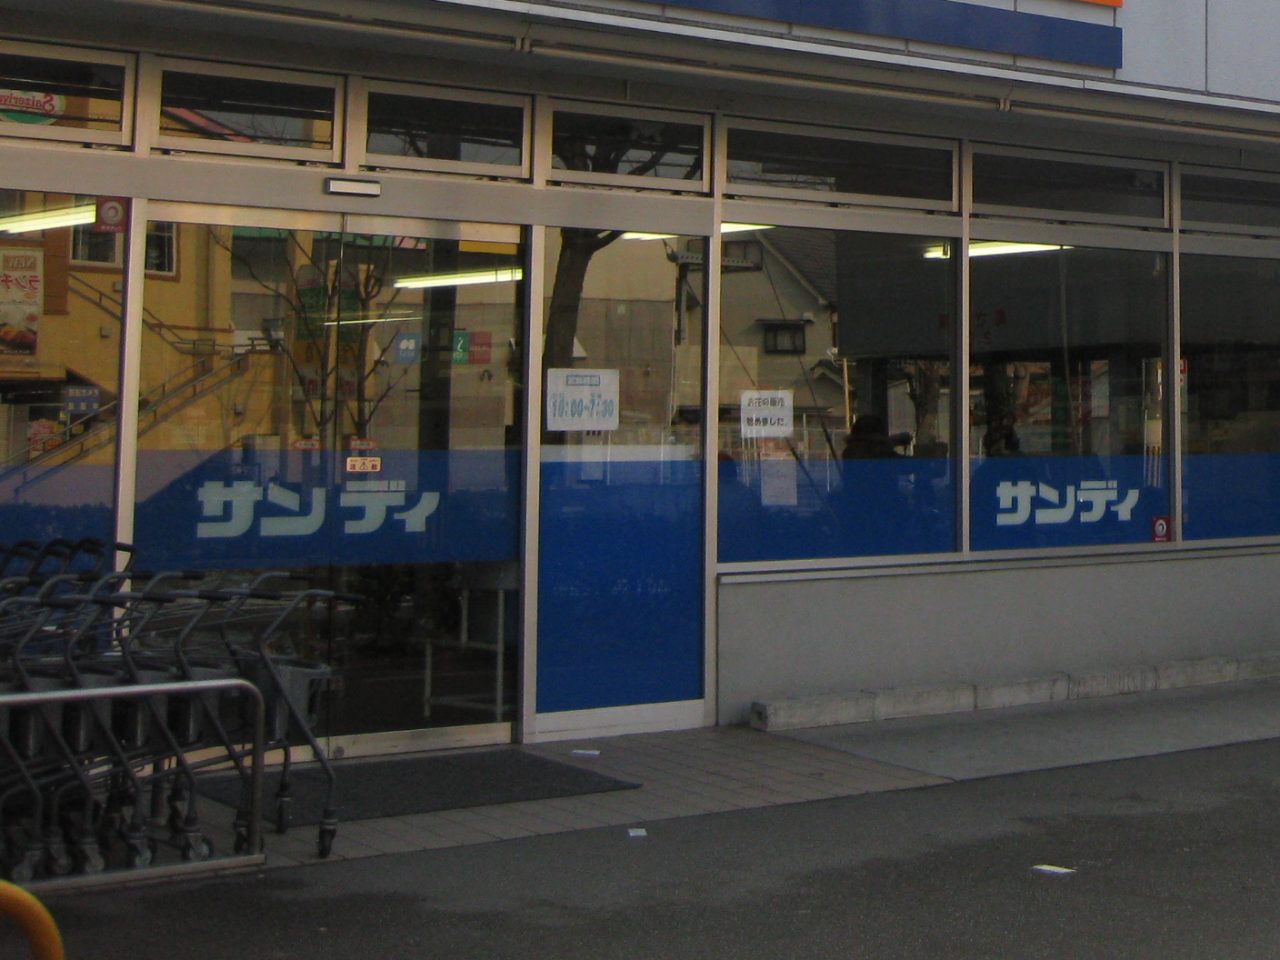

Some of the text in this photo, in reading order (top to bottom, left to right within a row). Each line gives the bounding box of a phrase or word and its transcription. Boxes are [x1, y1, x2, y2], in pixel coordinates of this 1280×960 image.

[196, 480, 441, 538] サンディ
[996, 480, 1140, 526] サンディ
